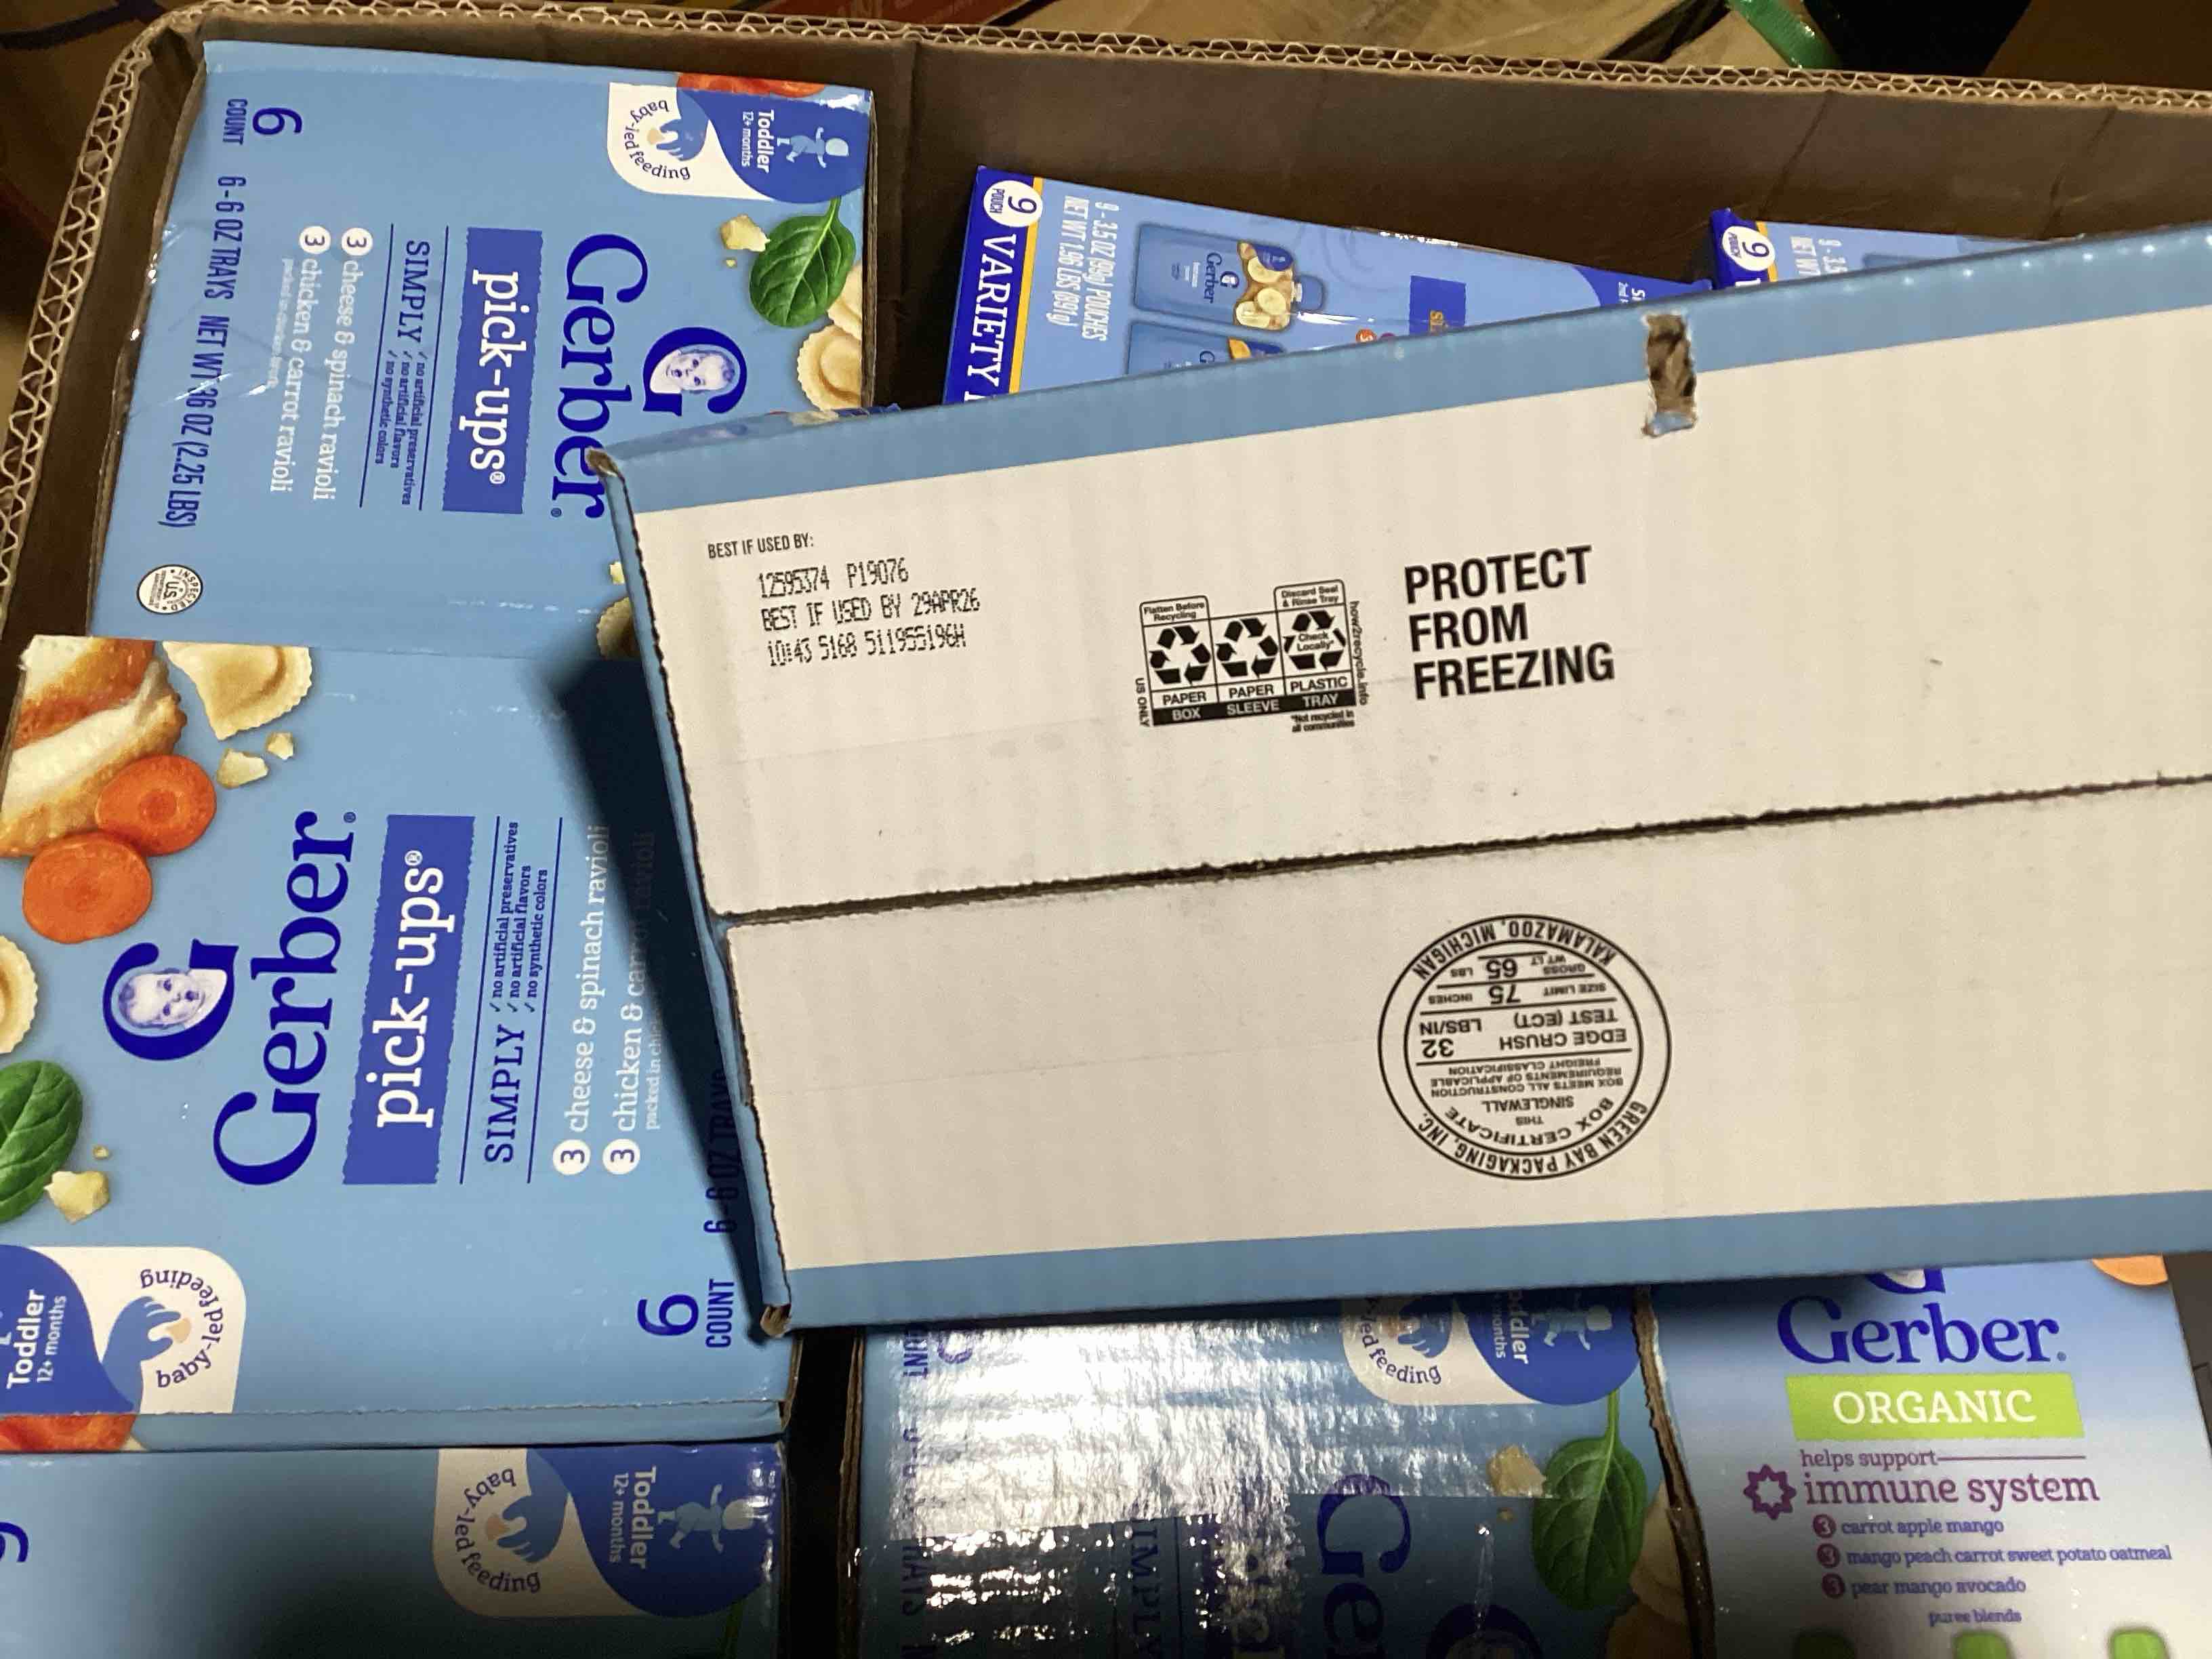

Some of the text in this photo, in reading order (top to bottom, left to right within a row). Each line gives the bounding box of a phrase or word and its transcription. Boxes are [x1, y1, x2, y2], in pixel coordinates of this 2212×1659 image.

[223, 98, 248, 146] COUNT
[253, 107, 303, 136] 6
[741, 128, 754, 167] months
[756, 108, 775, 173] Toddler
[633, 150, 691, 181] feeding
[989, 187, 1005, 216] POUCH
[1007, 196, 1038, 215] 9
[213, 219, 243, 242] OZ
[1055, 194, 1090, 291] NET WT 1.96 LBS
[204, 247, 241, 300] TRAYS
[397, 240, 430, 344] SIMPLY
[1081, 240, 1116, 342] OZ POUCHES
[1202, 252, 1222, 304] Gerber
[293, 258, 323, 334] chicken
[966, 233, 1017, 387] VARIETY
[196, 314, 230, 348] NET
[291, 339, 312, 352] &
[190, 352, 224, 381] WT
[312, 260, 364, 500] cheese & spinach ravioli
[280, 356, 306, 421] carrot
[394, 378, 411, 426] artificial
[180, 413, 214, 436] OZ
[401, 378, 428, 506] artificial preservatives
[171, 441, 209, 485] (2.25
[270, 424, 297, 493] ravioli
[375, 428, 387, 465] colors
[157, 489, 201, 528] LBS)
[708, 532, 815, 560] BEST IF USED BY:
[846, 557, 909, 589] P19076
[1281, 585, 1339, 598] Discard Seal
[1404, 544, 1593, 605] PROTECT
[760, 586, 981, 632] BEST IF USED BY 29APR26
[1143, 600, 1206, 615] Flatten Before
[1153, 611, 1197, 623] Recycling
[1291, 594, 1340, 607] Rinse Tray
[1298, 631, 1330, 642] Check
[1409, 602, 1530, 652] FROM
[817, 631, 858, 661] 5168
[1349, 600, 1371, 706] how2recycle.info
[1290, 676, 1349, 693] PLASTIC
[1414, 642, 1616, 701] FREEZING
[1134, 677, 1151, 727] US ONLY
[1162, 691, 1208, 705] PAPER
[1227, 699, 1281, 716] SLEEVE
[1228, 684, 1275, 699] PAPER
[1302, 693, 1340, 708] TRAY
[1172, 706, 1202, 722] BOX
[1303, 719, 1356, 733] communities
[1309, 710, 1345, 723] recycled
[493, 821, 518, 980] artificial preservatives
[510, 865, 531, 980] artificial flavors
[528, 868, 548, 979] synthetic colors
[1411, 920, 1617, 981] KALAMAZOO, MICHIGAN
[1485, 958, 1519, 980] 65
[564, 824, 610, 1133] cheese & spinach ravioli
[1450, 967, 1474, 978] LBS
[1542, 963, 1586, 976] GROSS
[213, 811, 354, 1186] Gerber
[1427, 992, 1473, 1006] INCHES
[1488, 983, 1521, 1006] 75
[1542, 982, 1607, 998] SIZE LIMIT
[1418, 1017, 1483, 1036] LBS/IN
[1513, 1007, 1618, 1030] TEST (ECT)
[1420, 1038, 1455, 1059] 32
[1498, 1027, 1628, 1051] EDGE CRUSH
[612, 1003, 644, 1133] chicken &
[1430, 1067, 1622, 1088] REQUIREMENTS APPLICABLE
[1448, 1057, 1601, 1076] FREIGHT CLASSIFICATION
[484, 1024, 525, 1164] SIMPLY
[646, 1073, 661, 1131] packed
[1431, 1077, 1624, 1098] BOX MEETS ALL CONSTRUCTION
[1481, 1095, 1575, 1114] SINGLEWALL
[1417, 1100, 1650, 1176] GREEN BAY PACKAGING, INC.
[1444, 1097, 1614, 1148] BOX CERTIFICATE
[1515, 1115, 1544, 1127] THIS
[140, 1269, 220, 1308] feeding
[637, 1294, 699, 1337] 6
[705, 1278, 735, 1349] COUNT
[1777, 1295, 2060, 1365] Gerber
[6, 1288, 46, 1389] Toddler
[36, 1294, 68, 1384] 12+ months
[1368, 1347, 1443, 1385] feeding
[1832, 1389, 2037, 1426] ORGANIC
[1801, 1449, 1939, 1473] helps support
[1804, 1473, 2101, 1512] immune system
[609, 1499, 626, 1563] months
[630, 1465, 658, 1570] Toddler
[1841, 1517, 2005, 1538] carrot apple mango
[461, 1552, 541, 1593] feeding
[1847, 1544, 2173, 1568] mango peach carrot sweet potato oatmeal
[1851, 1580, 1889, 1597] pear
[1894, 1580, 1954, 1598] mango
[1956, 1576, 2027, 1594] avocado
[1928, 1608, 2022, 1629] puree blends
